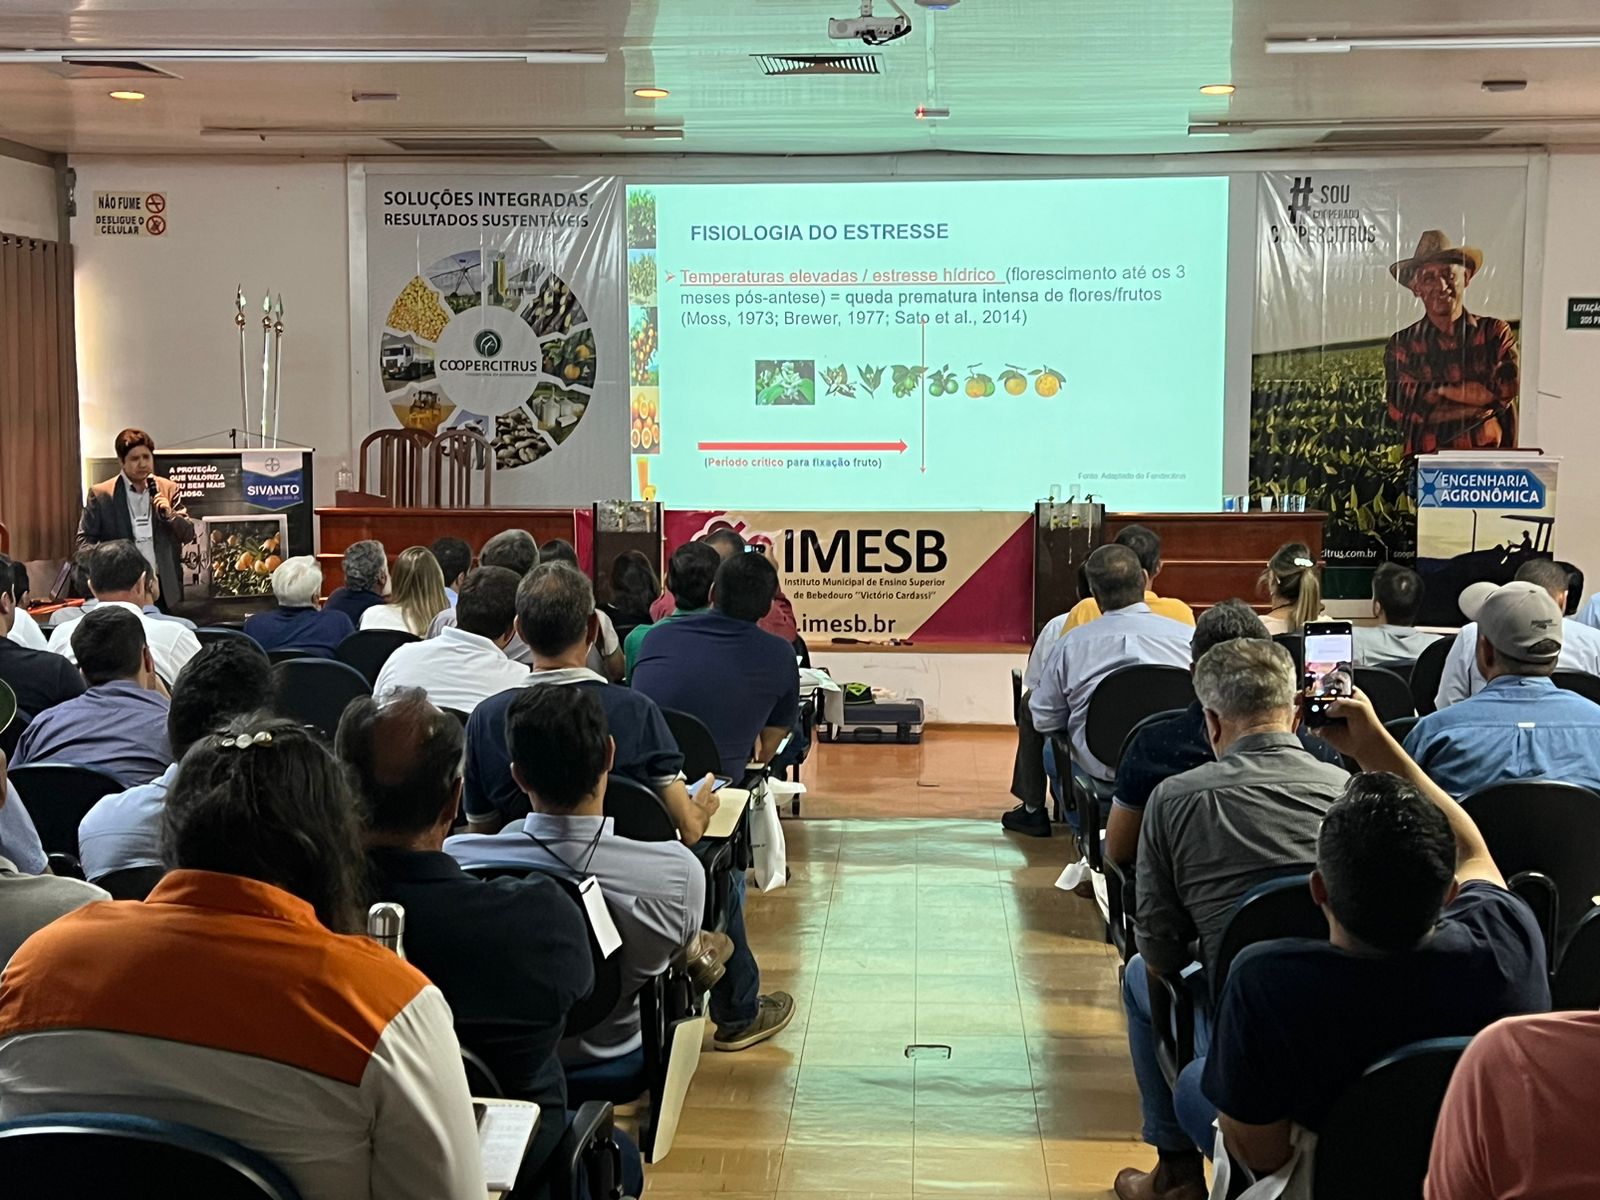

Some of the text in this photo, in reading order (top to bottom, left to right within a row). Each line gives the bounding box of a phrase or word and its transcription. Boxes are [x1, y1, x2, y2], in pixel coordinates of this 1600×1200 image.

[98, 193, 141, 209] NÃO FUME
[384, 189, 593, 210] SOLUÇÕES INTEGRADAS,
[1321, 184, 1350, 204] SOU
[96, 215, 144, 225] DESLIGUE O
[384, 209, 589, 227] RESULTADOS SUSTENTÁVEIS
[101, 225, 139, 235] CELULAR
[691, 223, 949, 241] FISIOLOGIA DO ESTRESSE
[680, 265, 1186, 286] Temperaturas elevadas / estresse hídrico (florescimento até os 3
[680, 291, 731, 305] meses
[735, 290, 826, 307] pós-antese)
[845, 290, 893, 307] queda
[898, 289, 977, 307] prematura
[983, 288, 1039, 303] intensa
[1044, 288, 1064, 302] de
[1069, 287, 1162, 303] flores/frutos
[681, 309, 1028, 327] (Moss, 1973; Brewer, 1977; Sato et al., 2014)
[440, 360, 537, 372] COOPERCITRUS
[177, 465, 217, 473] PROTEÇÃO
[787, 459, 810, 469] para
[813, 457, 850, 469] fixação
[853, 457, 882, 468] fruto)
[1441, 474, 1529, 488] ENGENHARIA
[247, 484, 300, 496] SIVANTO
[1441, 488, 1539, 503] AGRONÔMICA
[784, 529, 947, 573] IMESB
[784, 578, 945, 588] Instituto Municipal de Ensino Superior
[793, 591, 804, 600] de
[806, 591, 853, 600] Bebedouro
